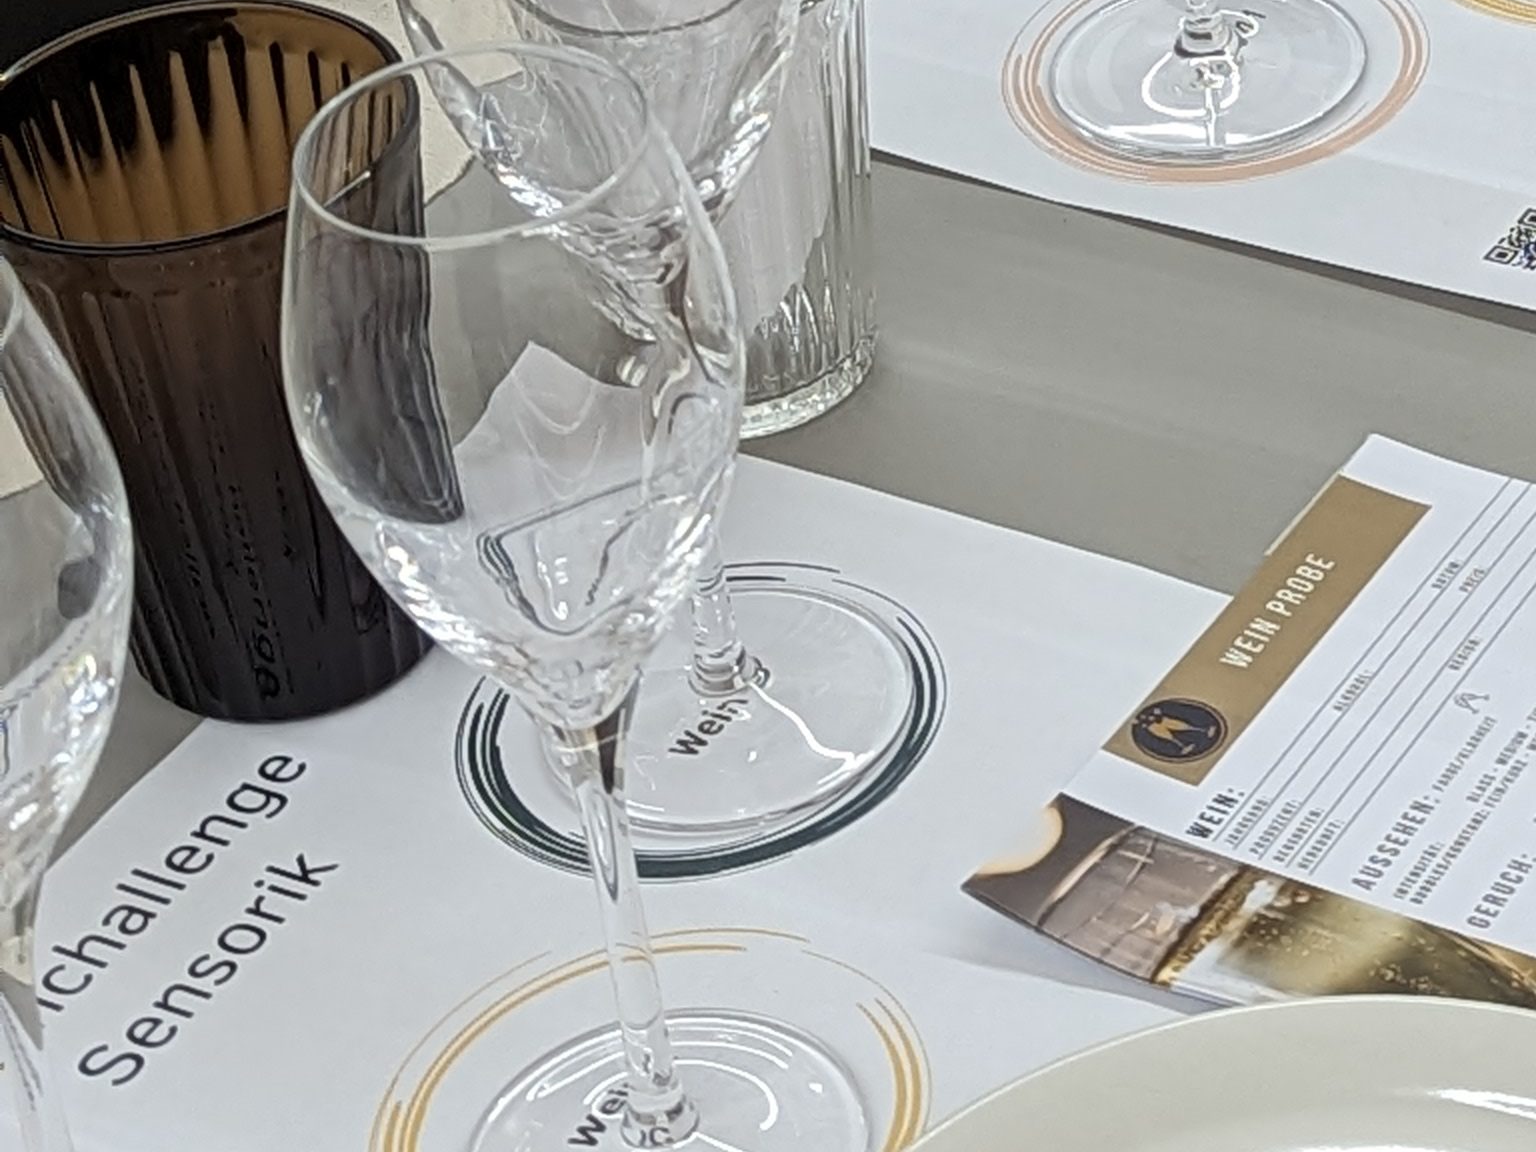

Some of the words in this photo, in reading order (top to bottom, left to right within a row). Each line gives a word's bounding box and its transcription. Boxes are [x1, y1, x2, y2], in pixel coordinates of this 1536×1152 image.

[1218, 616, 1280, 668] WEIN
[1264, 552, 1335, 616] PROBE
[669, 697, 749, 757] Wein
[1184, 787, 1244, 839] WEIN:
[1350, 794, 1440, 891] AUSSEHEN:
[77, 852, 341, 1087] Sensorik
[567, 1081, 629, 1147] Wei
